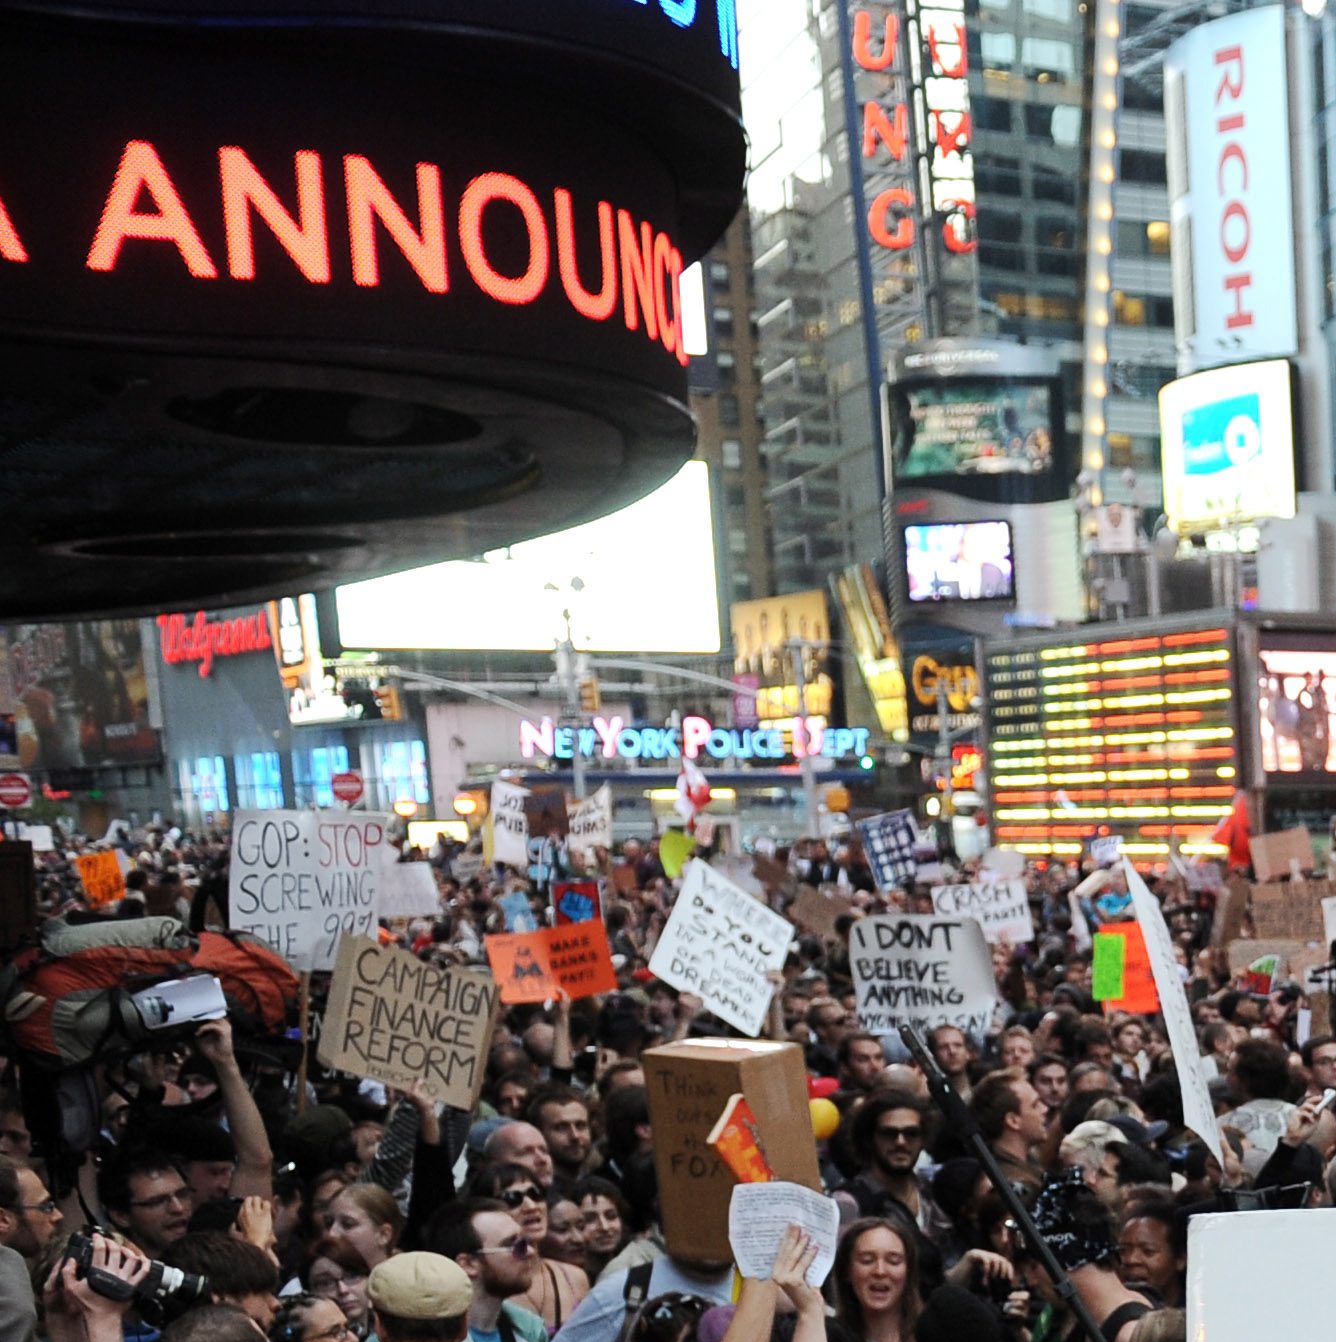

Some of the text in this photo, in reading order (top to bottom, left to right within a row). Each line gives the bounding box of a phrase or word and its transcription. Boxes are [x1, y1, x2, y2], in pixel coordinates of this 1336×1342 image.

[1211, 45, 1254, 333] RICOH
[156, 609, 272, 678] Walgreens
[519, 716, 597, 758] NEW
[593, 717, 680, 758] YORK
[682, 716, 785, 758] POLICE
[237, 820, 383, 868] GOP: STOP
[237, 871, 376, 914] SCREWING
[243, 923, 298, 962] THE
[855, 925, 867, 948] I
[356, 947, 498, 1018] CAMPAIGN
[856, 957, 950, 984] BELIEVE
[347, 985, 475, 1050] FINANCE
[863, 985, 965, 1009] ANYTHING
[342, 1019, 477, 1088] REFORM
[670, 1152, 725, 1179] FOX
